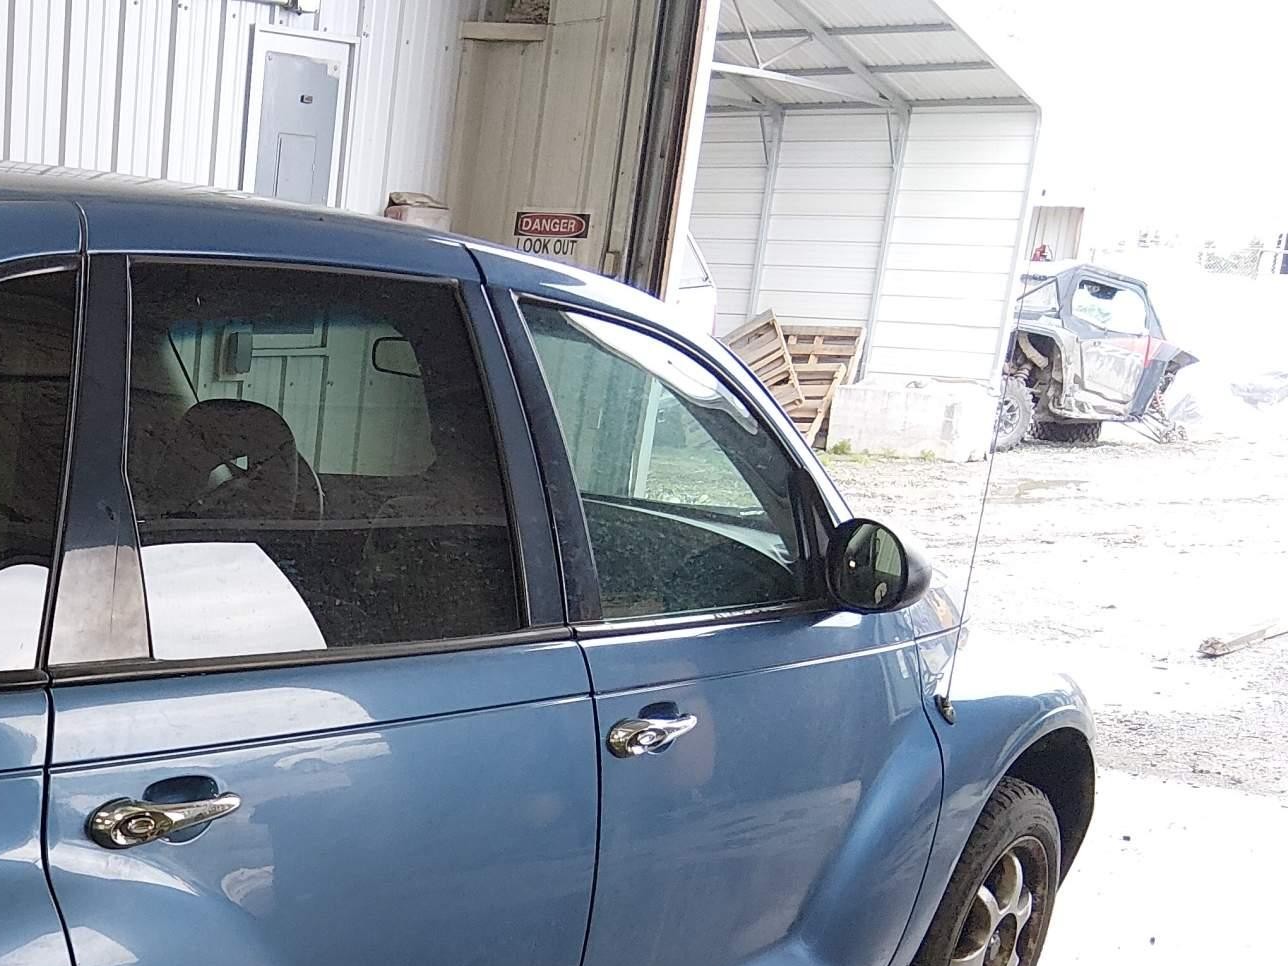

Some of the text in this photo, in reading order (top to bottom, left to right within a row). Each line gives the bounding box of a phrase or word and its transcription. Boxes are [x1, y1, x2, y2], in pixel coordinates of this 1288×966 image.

[521, 218, 576, 232] DANGER
[516, 237, 577, 255] LOOK OUT
